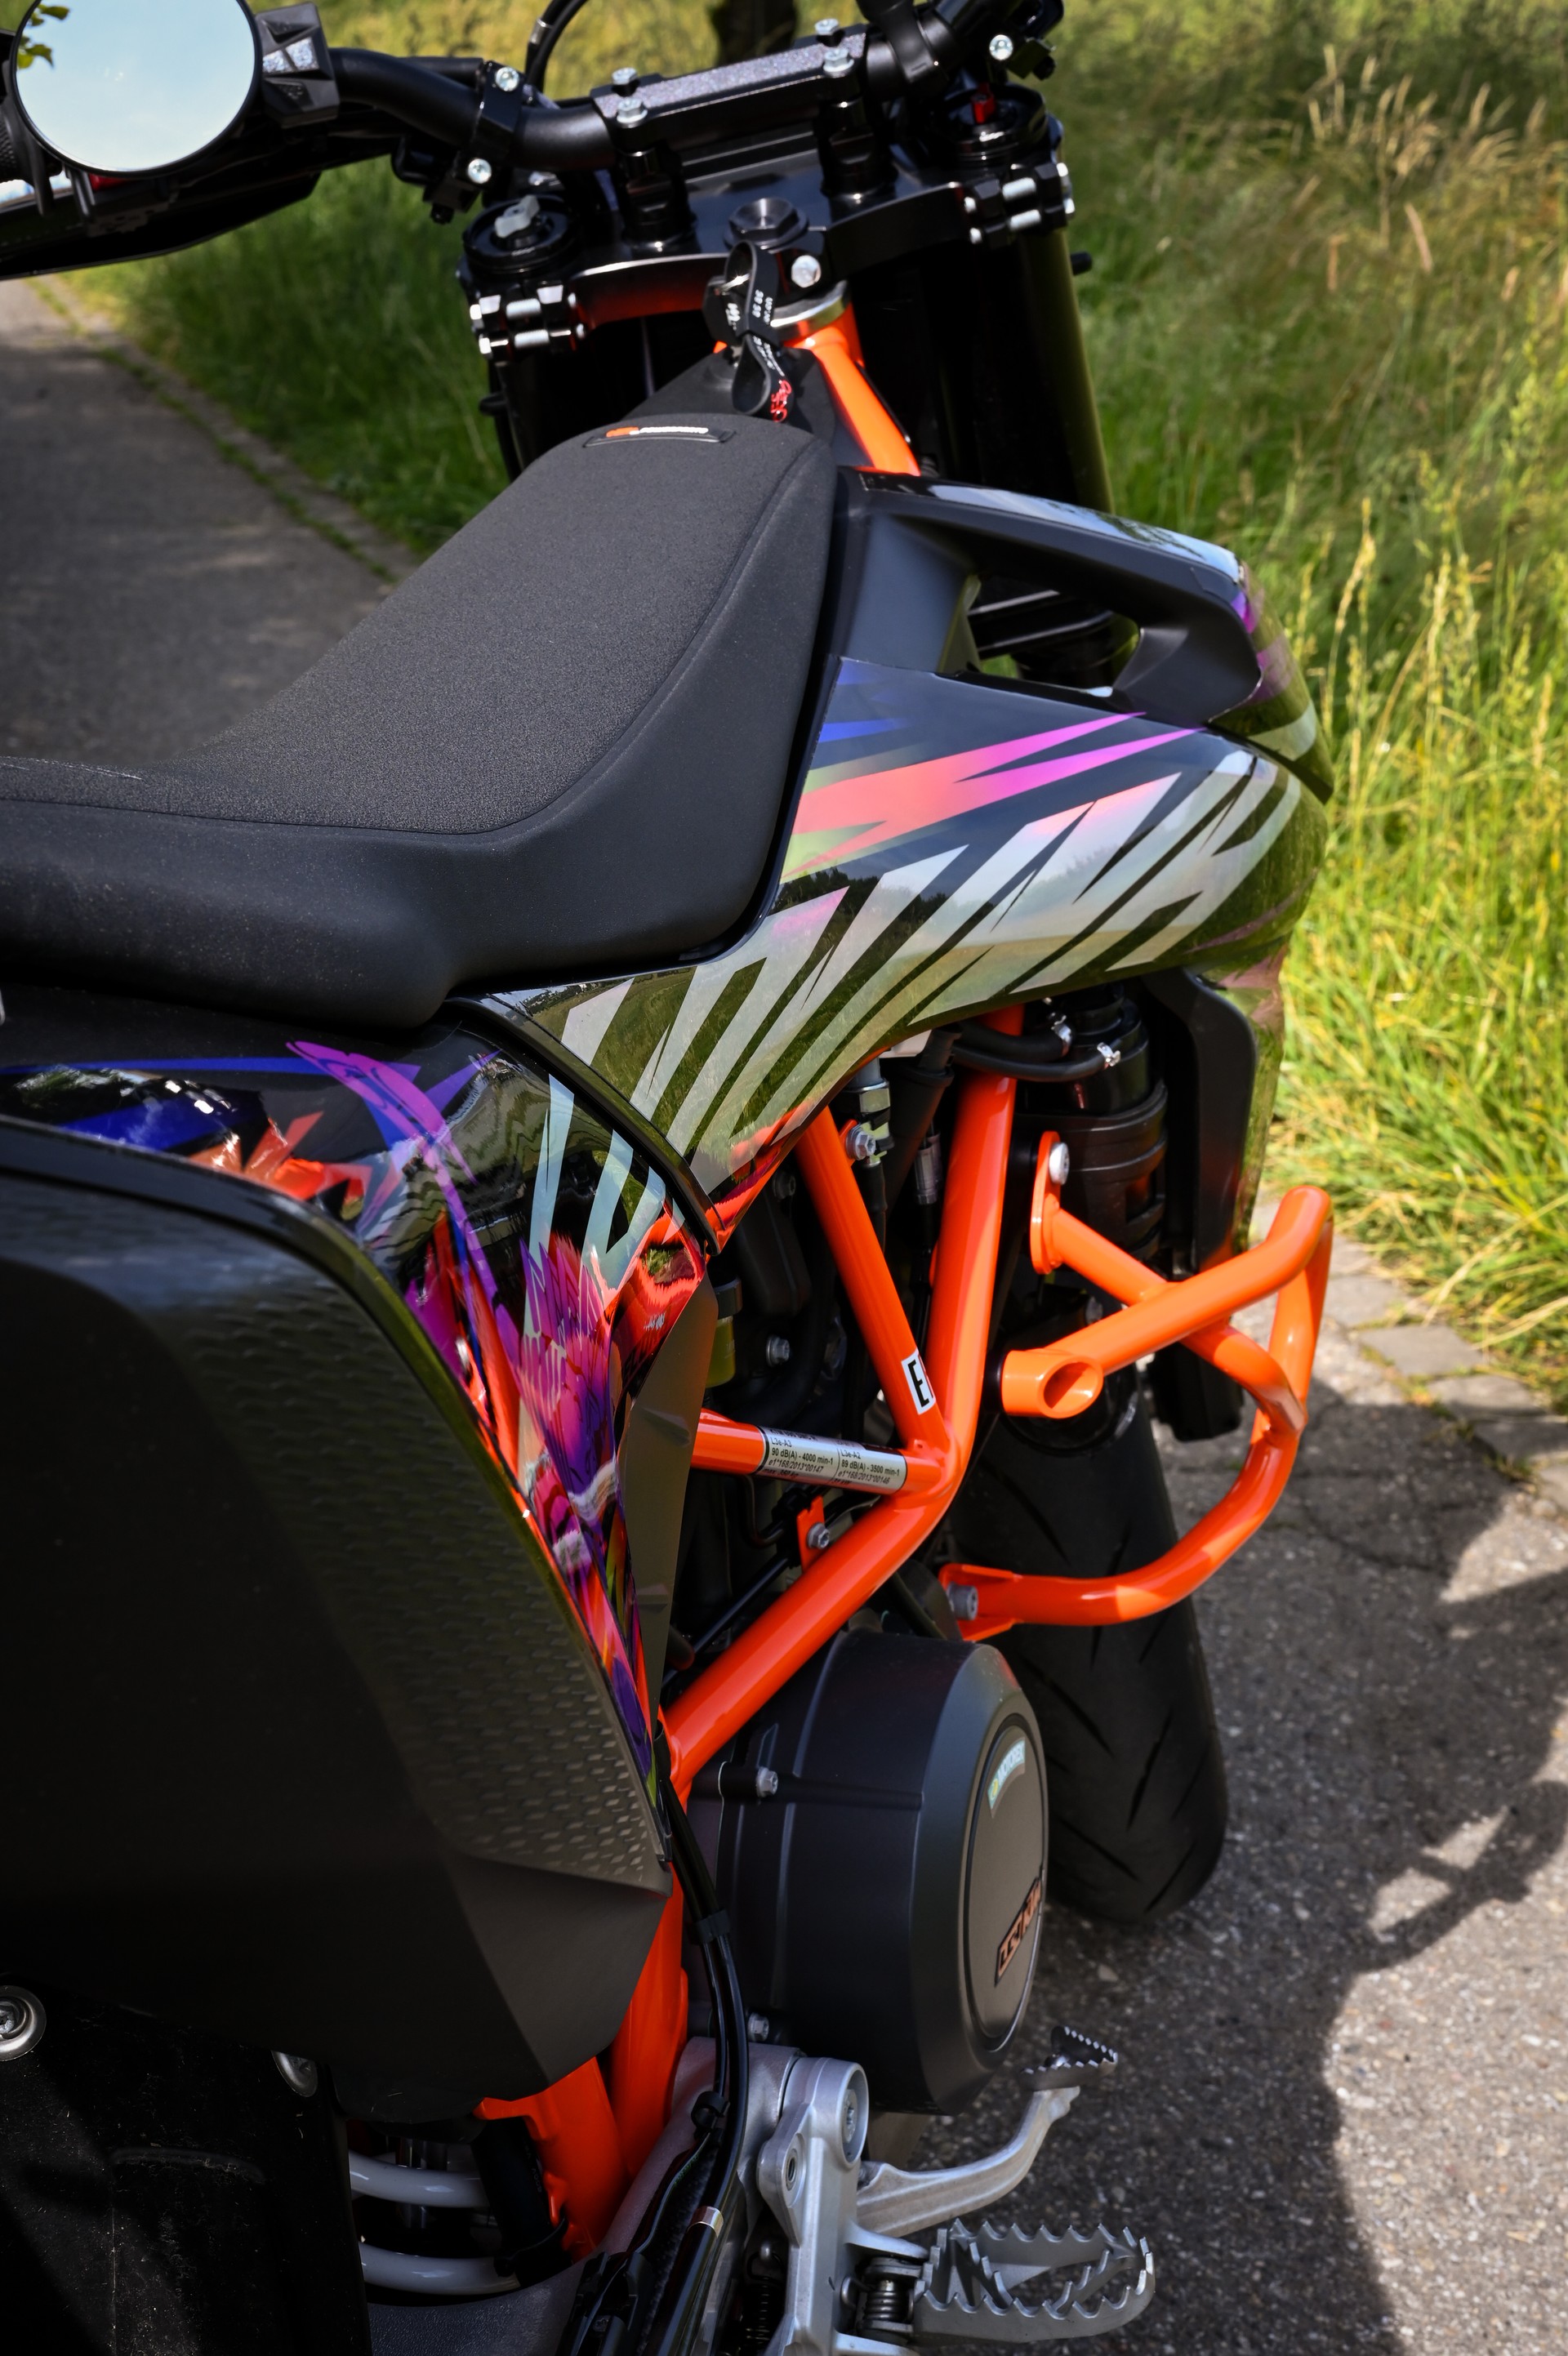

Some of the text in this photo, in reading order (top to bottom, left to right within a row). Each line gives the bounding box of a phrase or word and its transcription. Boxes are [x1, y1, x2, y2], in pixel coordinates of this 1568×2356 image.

[771, 1437, 792, 1448] L3e-A3
[771, 1448, 779, 1458] 90
[780, 1449, 798, 1461] dB(A)
[802, 1453, 817, 1463] 4000
[817, 1455, 833, 1465] min-1
[840, 1448, 861, 1459] L3e-A2
[841, 1459, 849, 1468] 89
[849, 1460, 866, 1472] dB(A)
[871, 1464, 884, 1474] 3500
[884, 1467, 900, 1476] min-1
